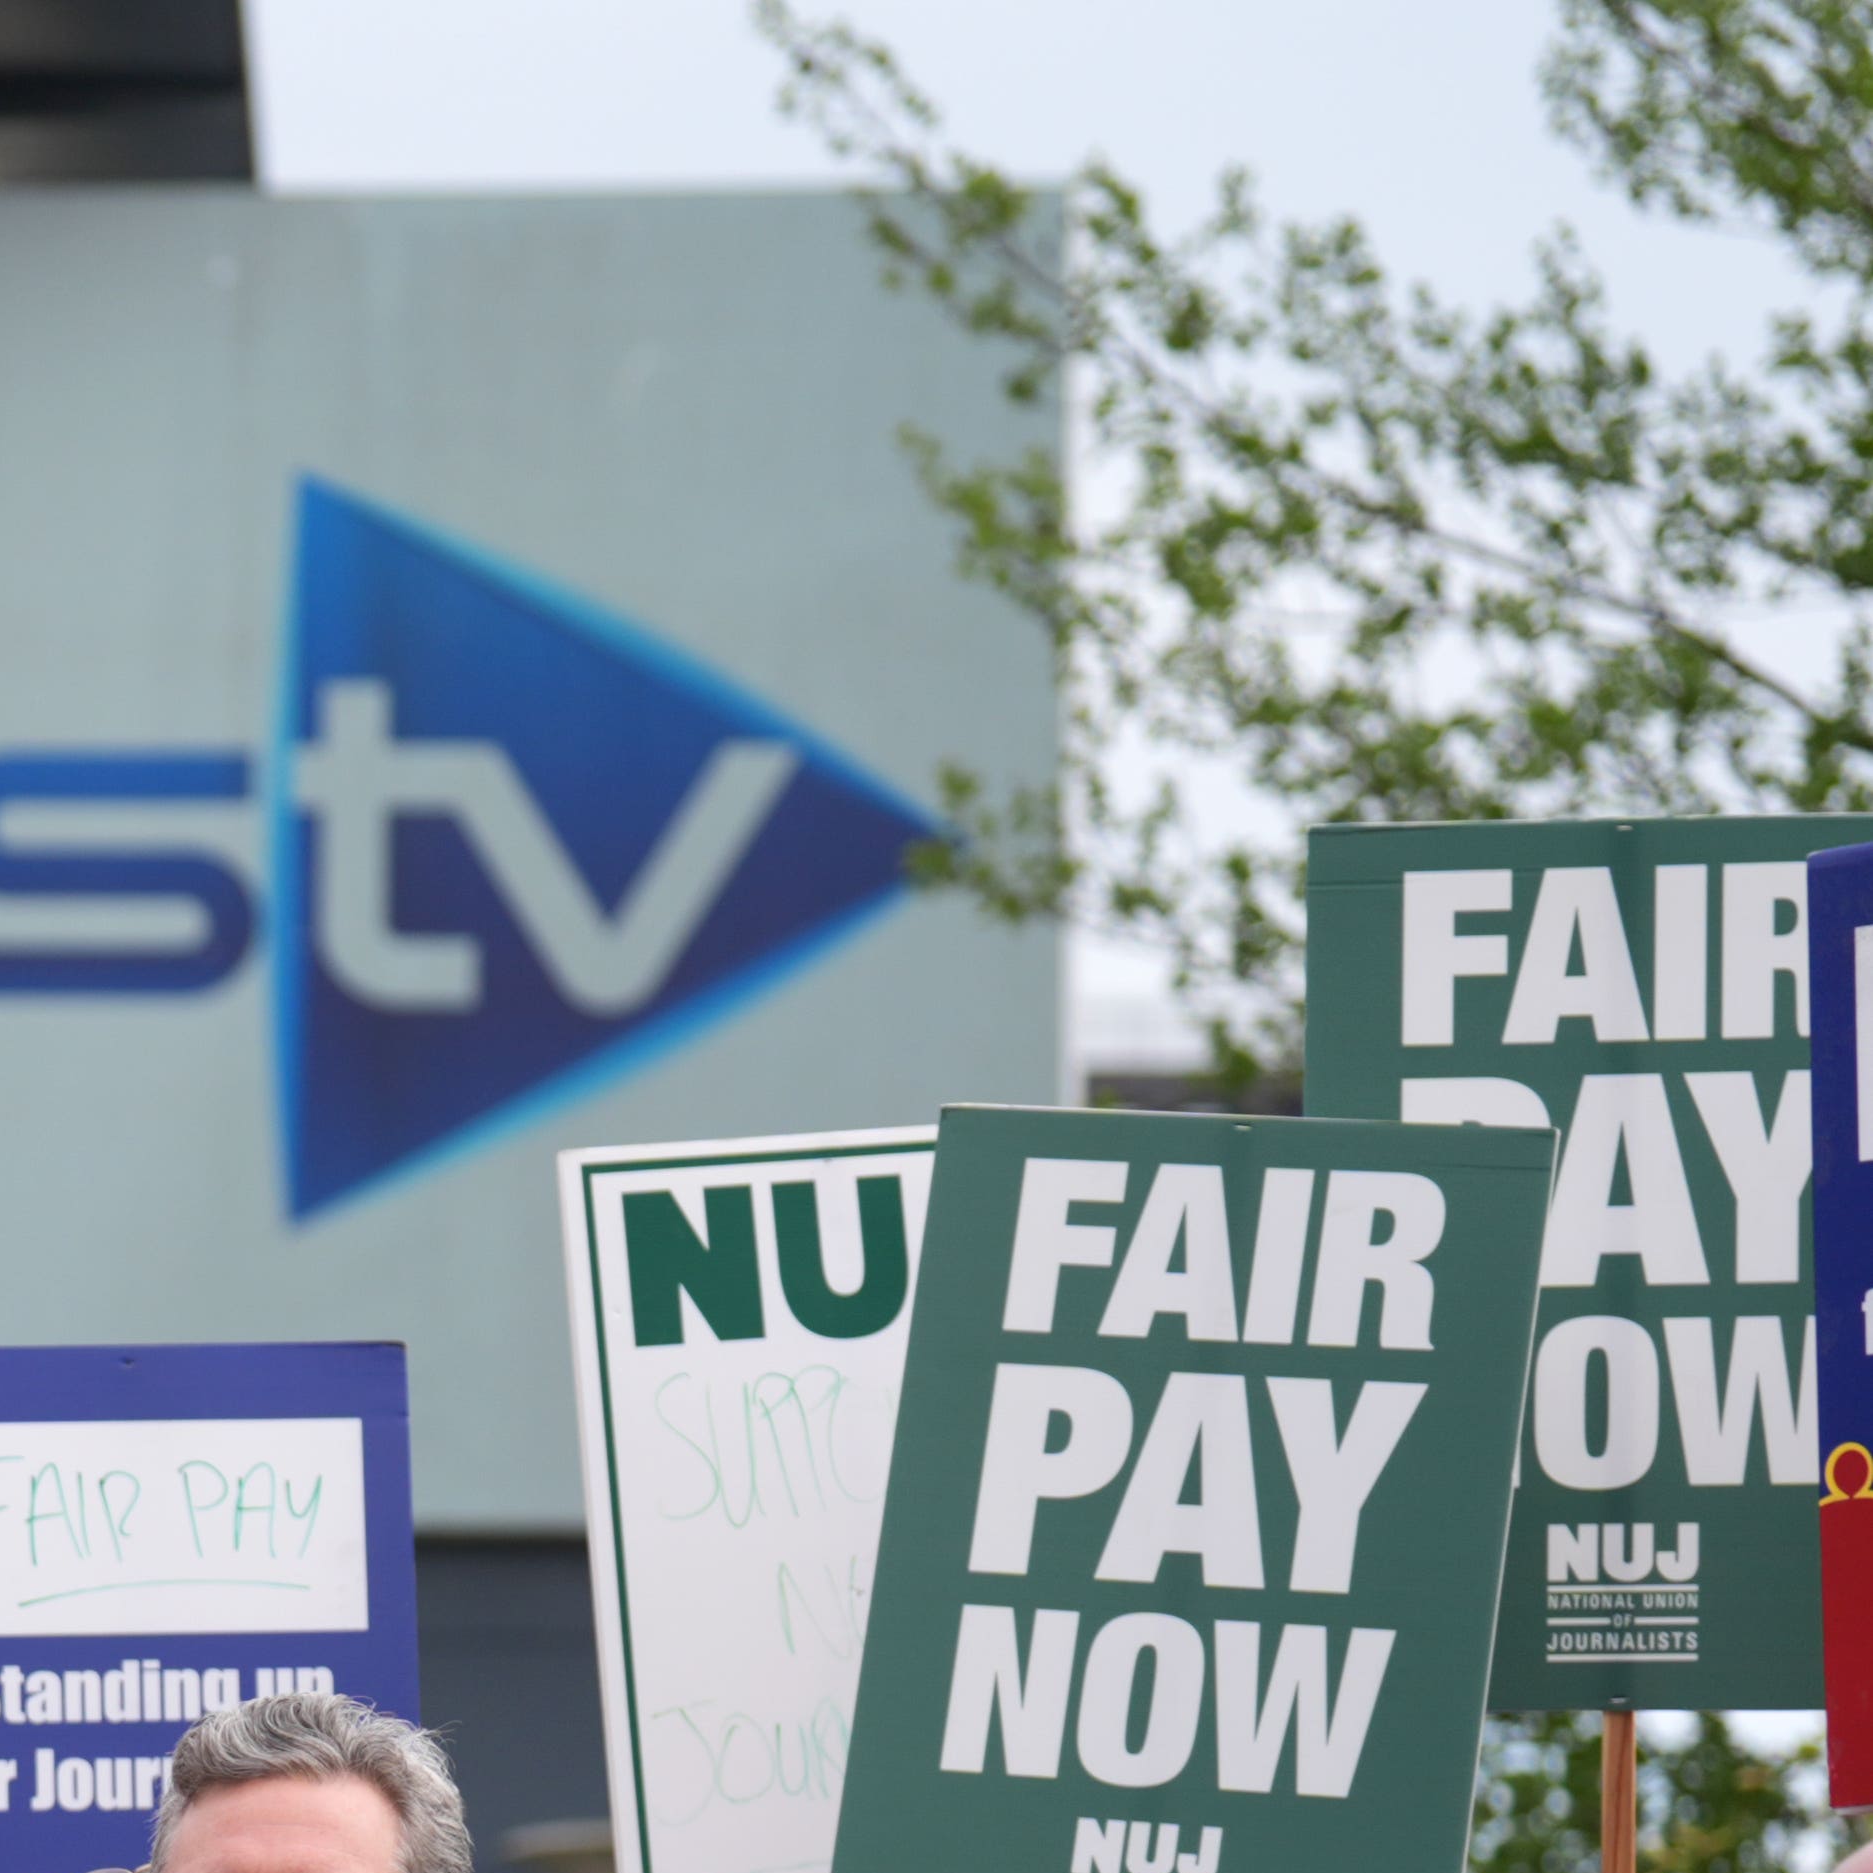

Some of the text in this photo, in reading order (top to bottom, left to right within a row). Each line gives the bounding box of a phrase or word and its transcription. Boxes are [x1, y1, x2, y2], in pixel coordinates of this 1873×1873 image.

[1401, 861, 1811, 1047] FAIR
[621, 1173, 909, 1348] NU
[1002, 1156, 1447, 1352] FAIR
[1401, 1069, 1813, 1288] AY
[967, 1362, 1429, 1595] PAY
[1514, 1315, 1820, 1490] OW
[178, 1460, 323, 1560] PAY
[1547, 1522, 1700, 1583] NUJ
[1546, 1631, 1699, 1652] JOURNALISTS
[1547, 1592, 1699, 1610] NATIONAL UNION
[1612, 1614, 1632, 1628] OF
[939, 1604, 1397, 1799] NOW
